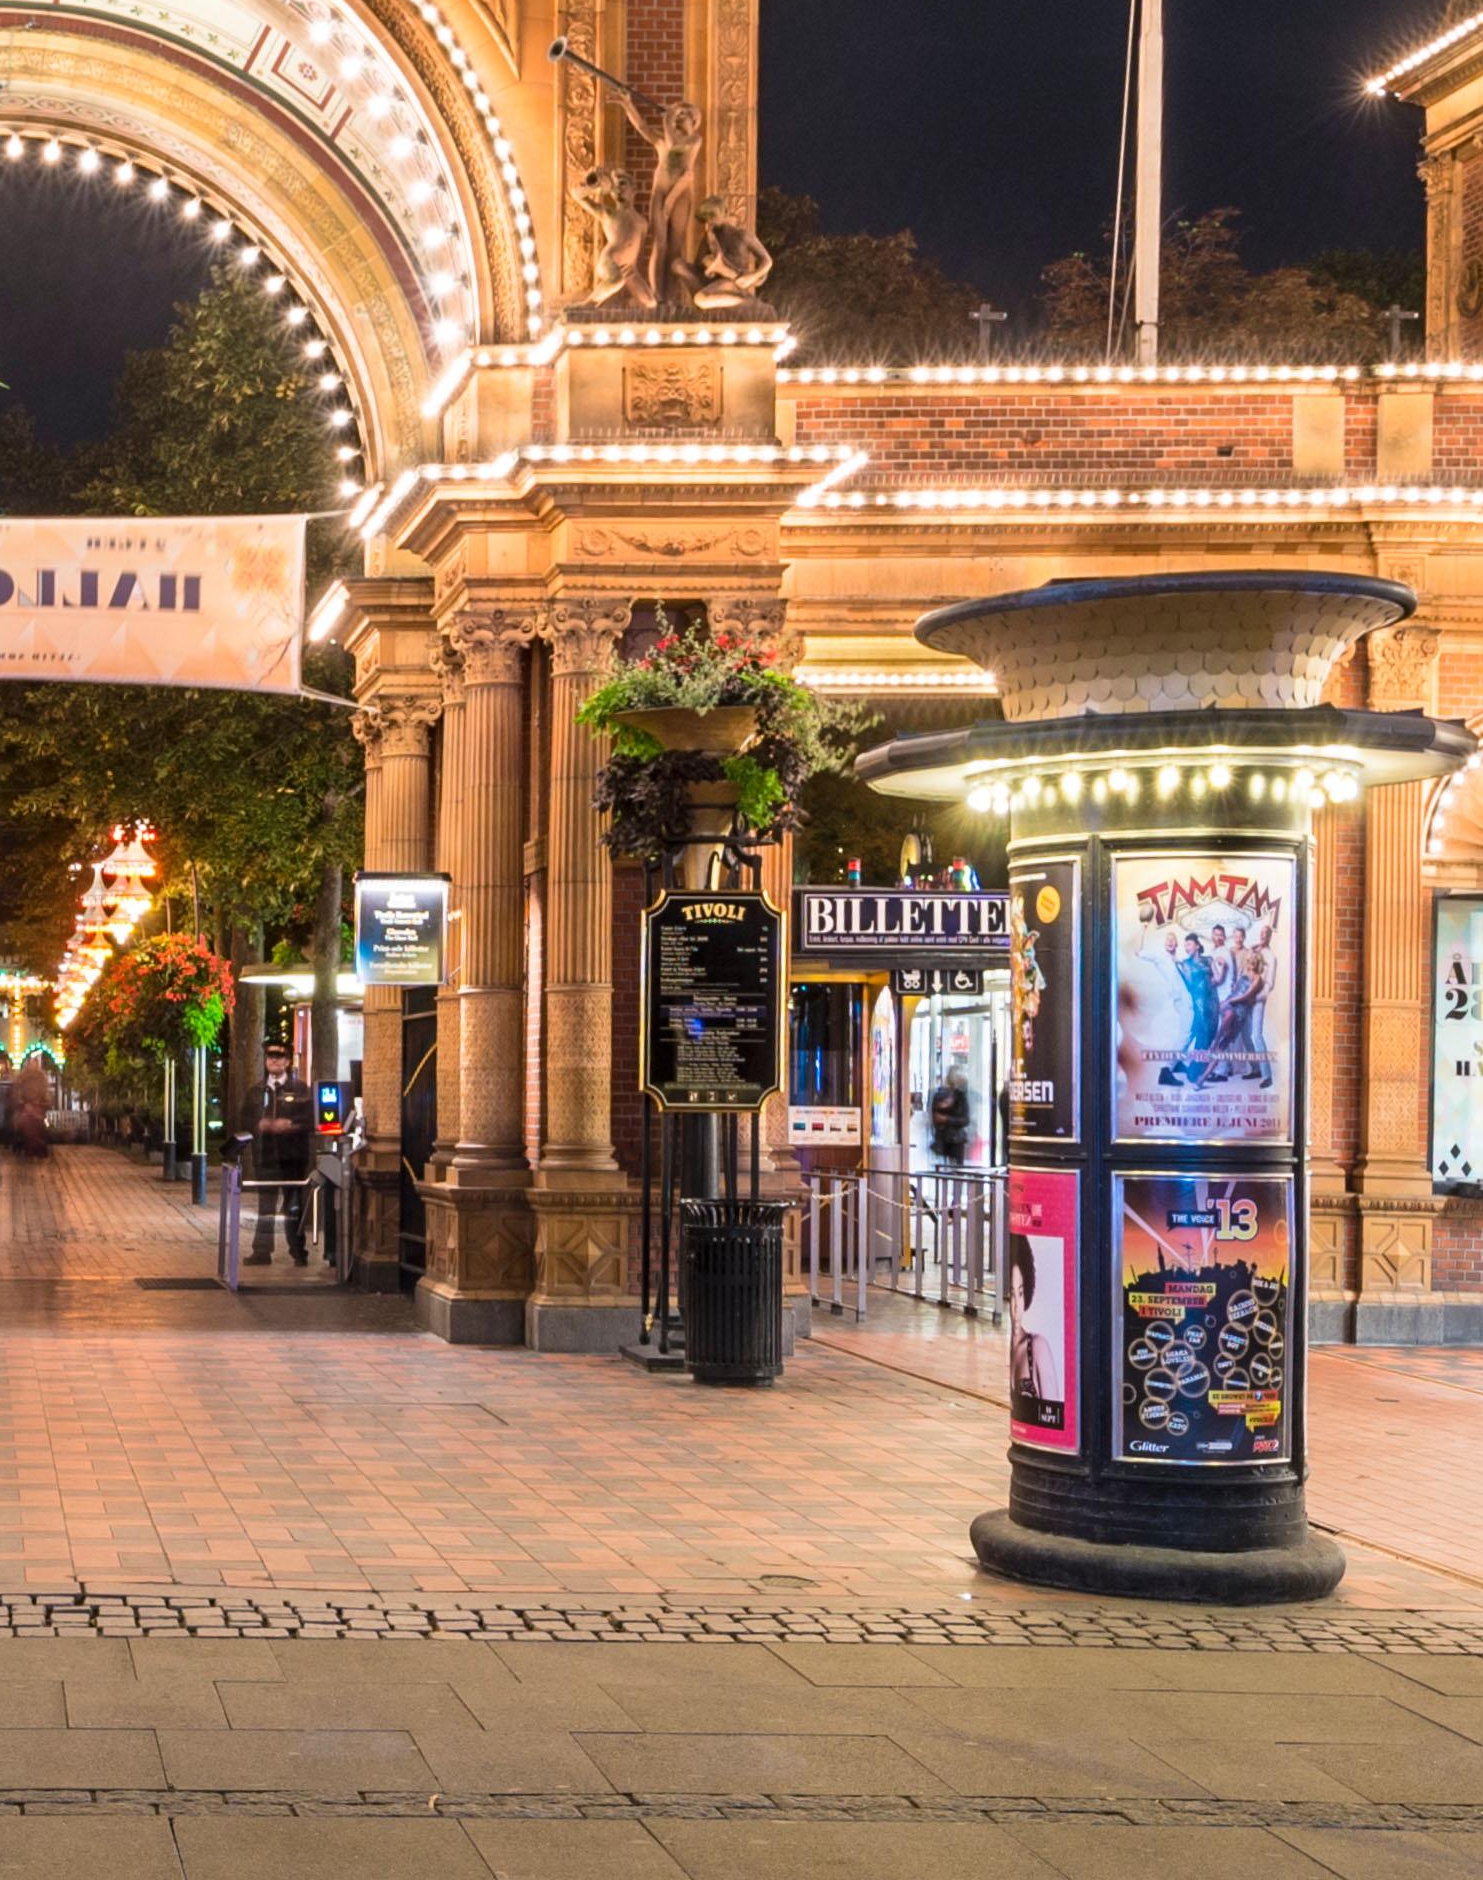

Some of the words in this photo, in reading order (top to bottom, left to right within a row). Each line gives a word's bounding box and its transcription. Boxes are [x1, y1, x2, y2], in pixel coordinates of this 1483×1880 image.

[681, 903, 746, 921] TIVOLI
[1135, 1116, 1212, 1127] PREMIERE
[1172, 1213, 1188, 1224] THE
[1190, 1214, 1215, 1224] VOICE
[1168, 1285, 1214, 1294] MANDAG
[1131, 1295, 1146, 1304] 23.
[1148, 1295, 1206, 1305] SEPTEMBER
[1148, 1307, 1182, 1316] TIVOLI
[1130, 1440, 1170, 1452] Glitter
